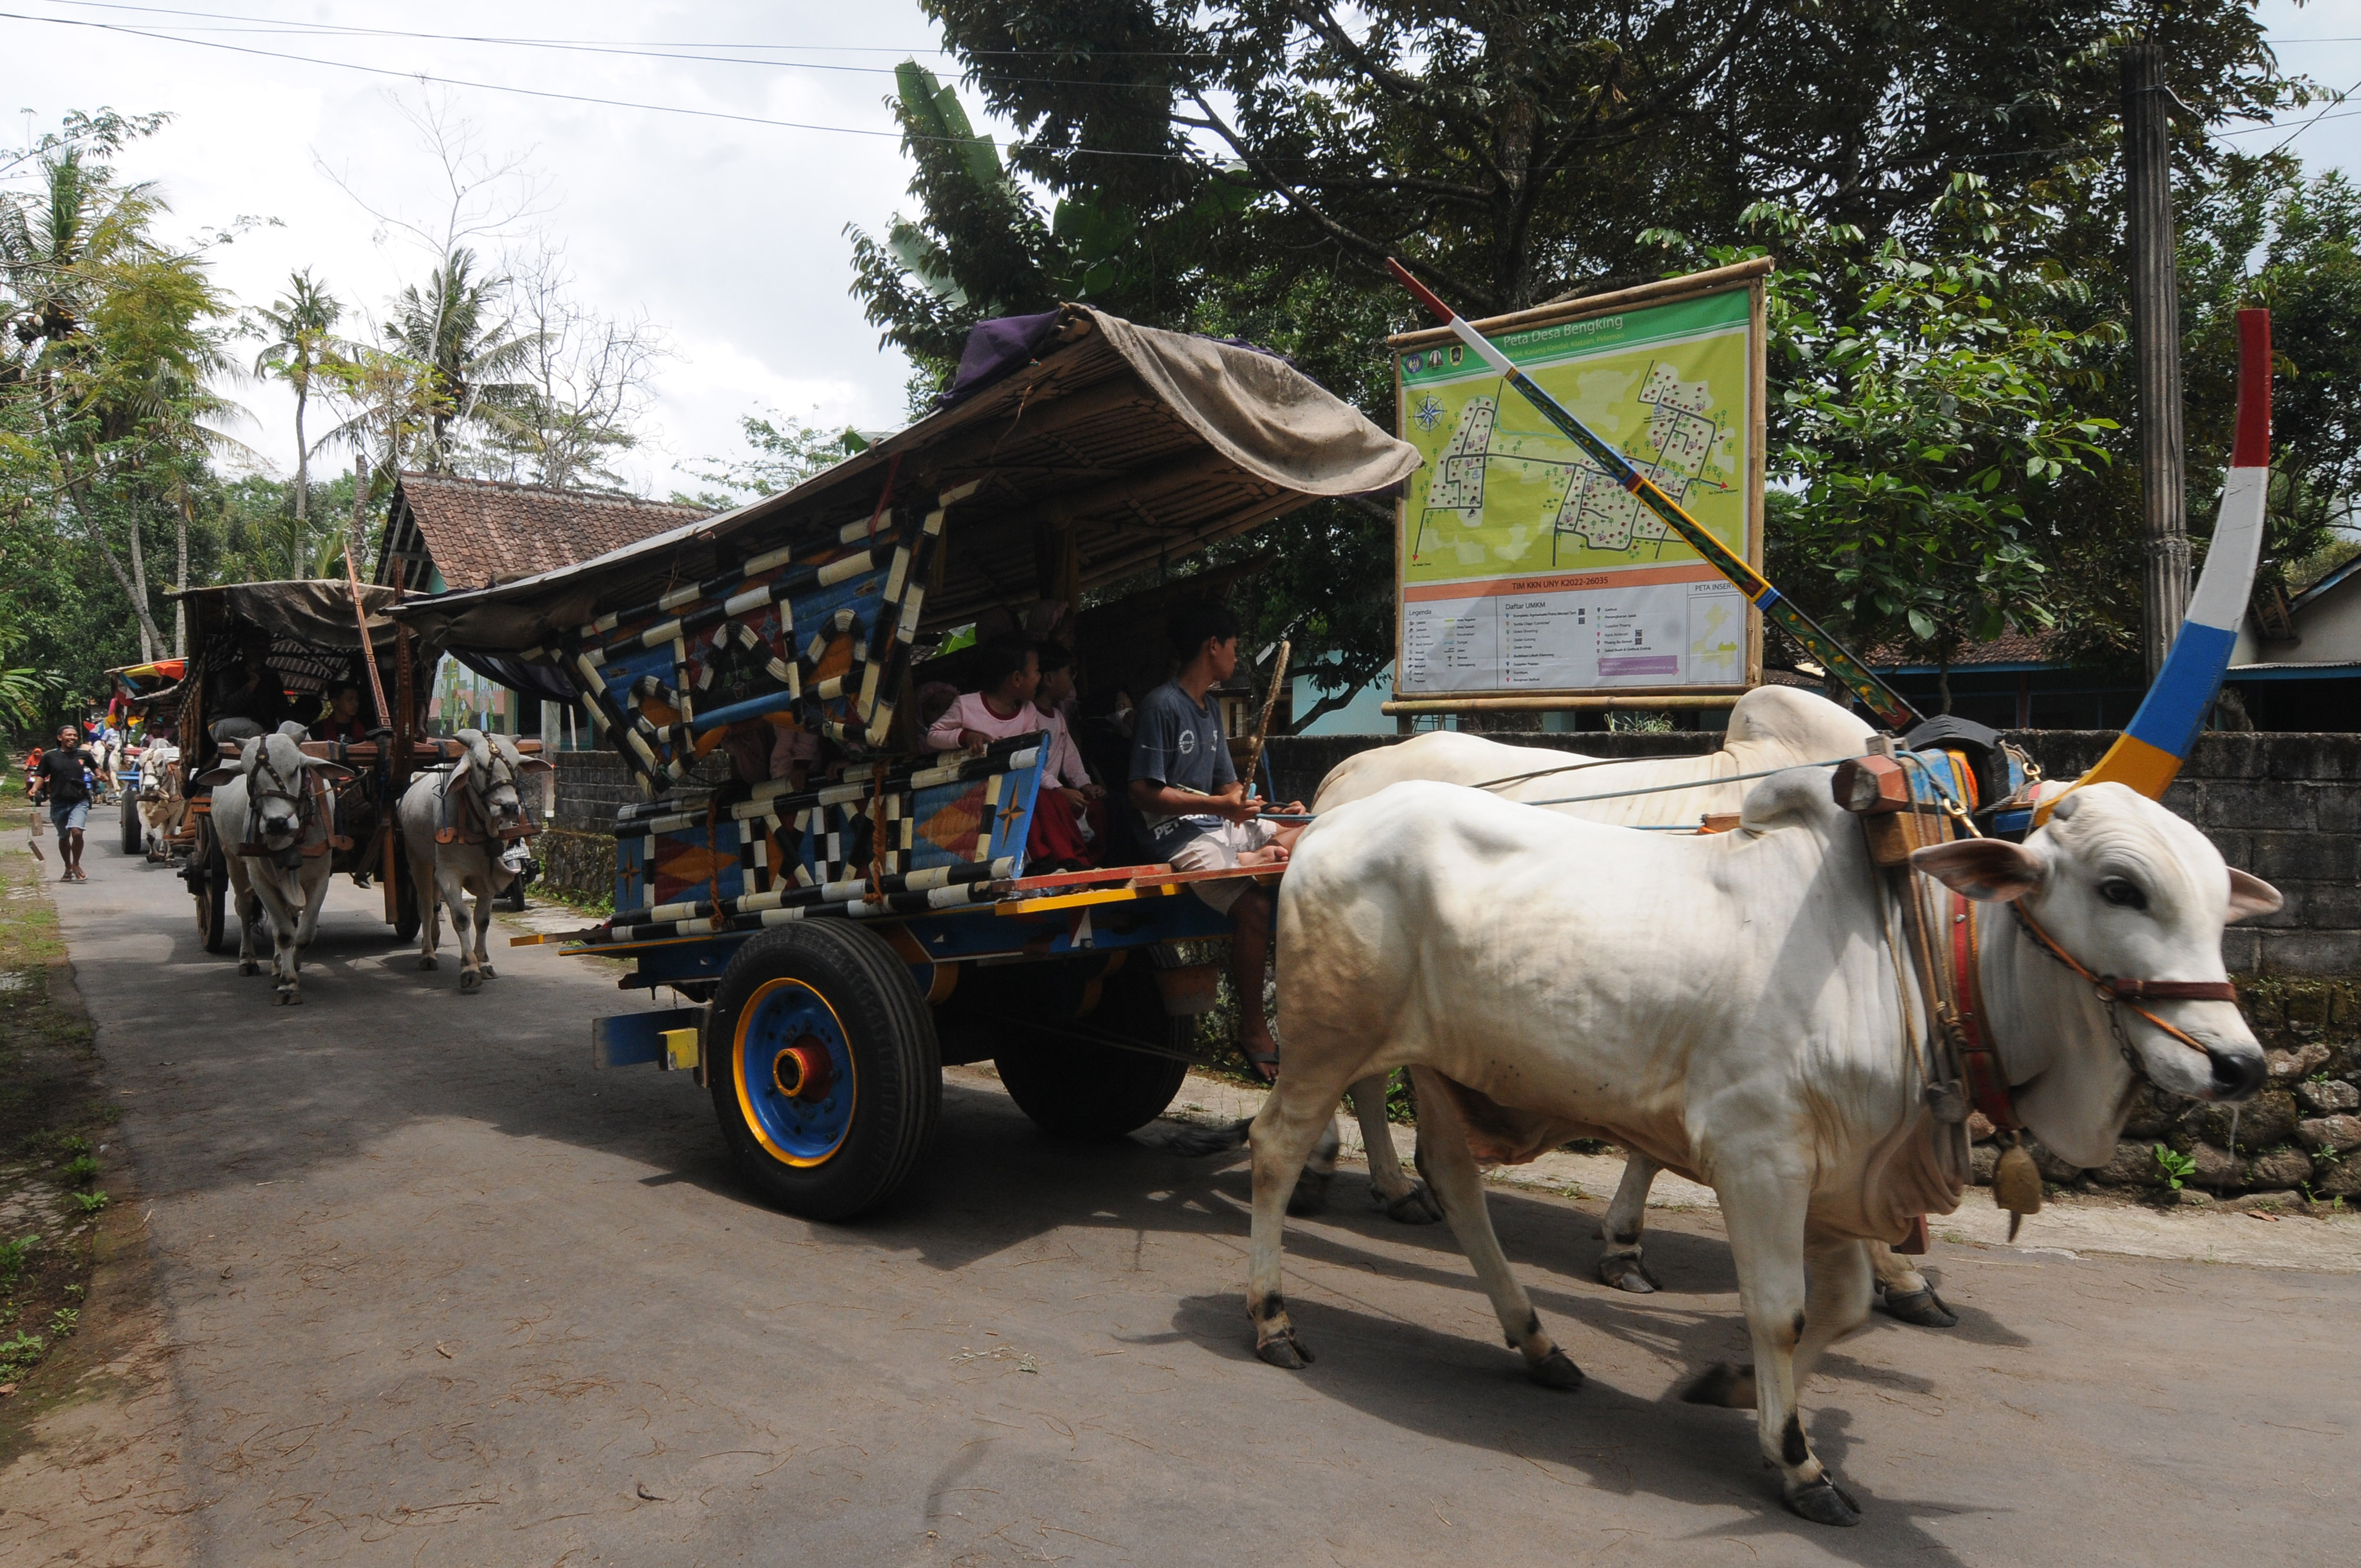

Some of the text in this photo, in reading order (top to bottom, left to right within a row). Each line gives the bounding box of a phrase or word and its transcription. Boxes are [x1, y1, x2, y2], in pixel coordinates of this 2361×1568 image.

[1503, 316, 1623, 347] Peta Desa Bengking
[1544, 580, 1559, 588] UNY
[1561, 577, 1608, 587] K2022-26035
